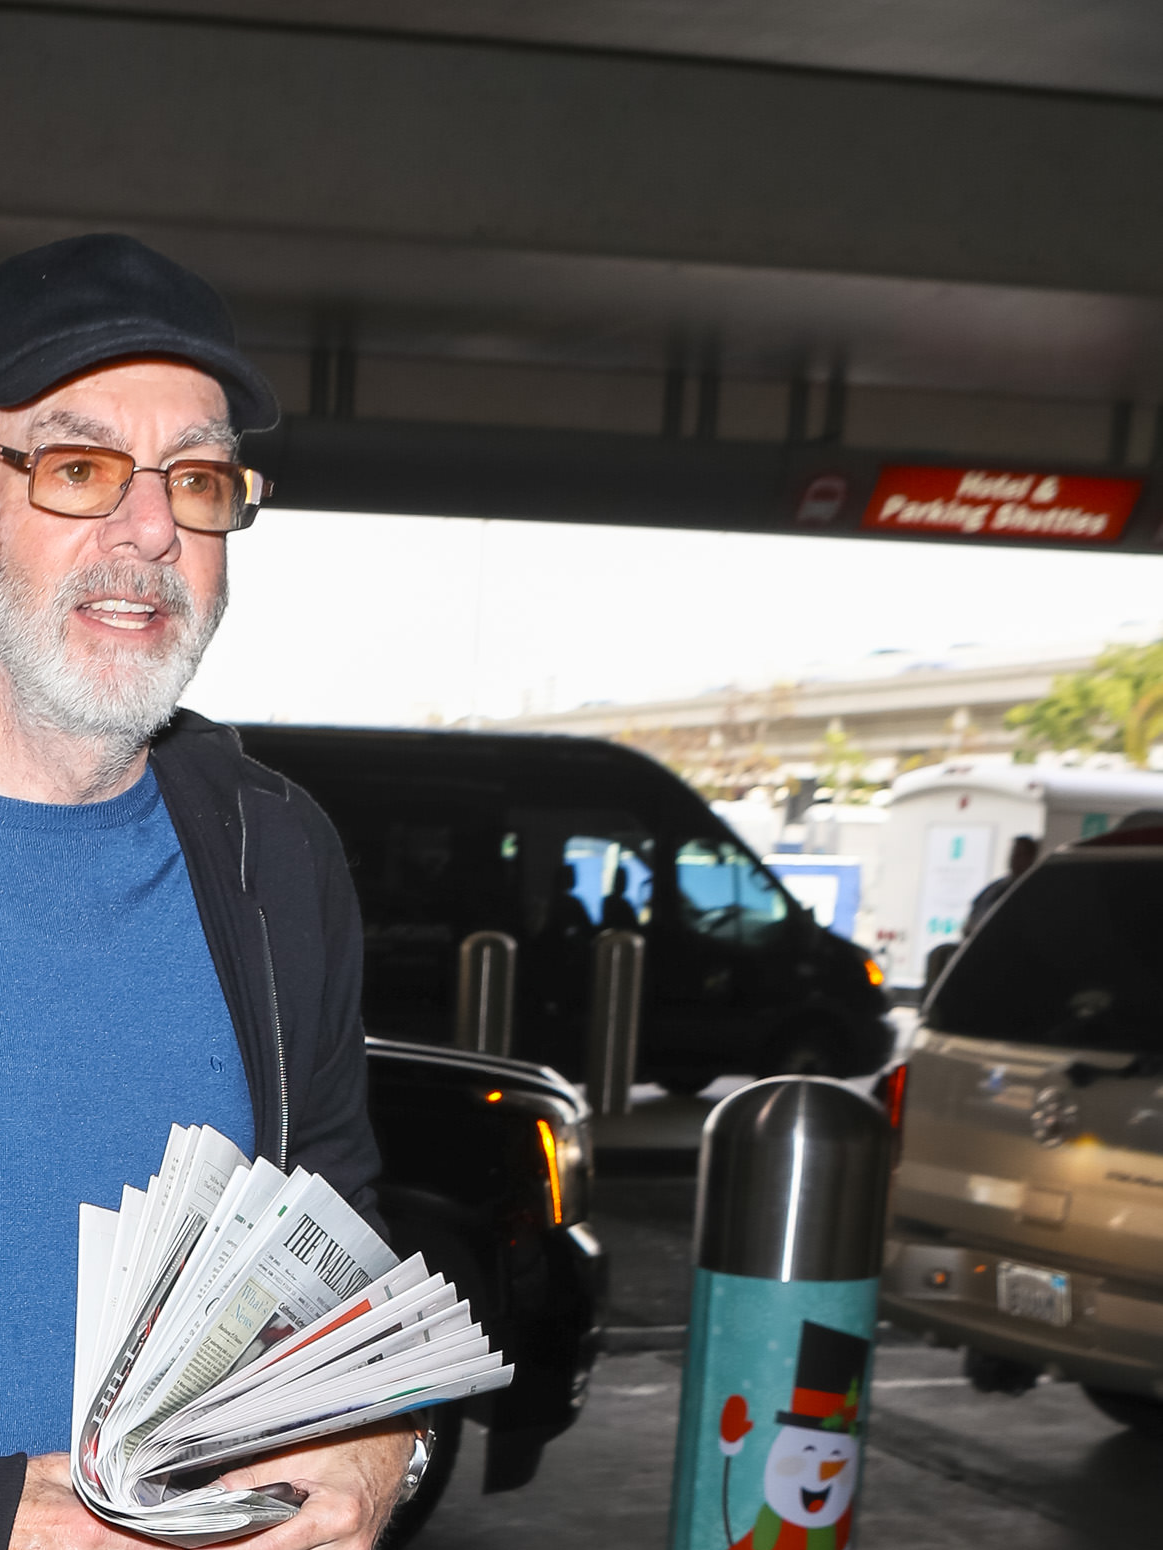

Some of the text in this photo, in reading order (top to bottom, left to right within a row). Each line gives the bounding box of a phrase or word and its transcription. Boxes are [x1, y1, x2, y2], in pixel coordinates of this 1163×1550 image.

[955, 470, 1060, 504] Hotel &
[878, 494, 1109, 536] Parking Shuttles
[283, 1213, 328, 1266] THE
[313, 1238, 356, 1292] WALL
[230, 1303, 254, 1328] News
[241, 1285, 269, 1315] What's
